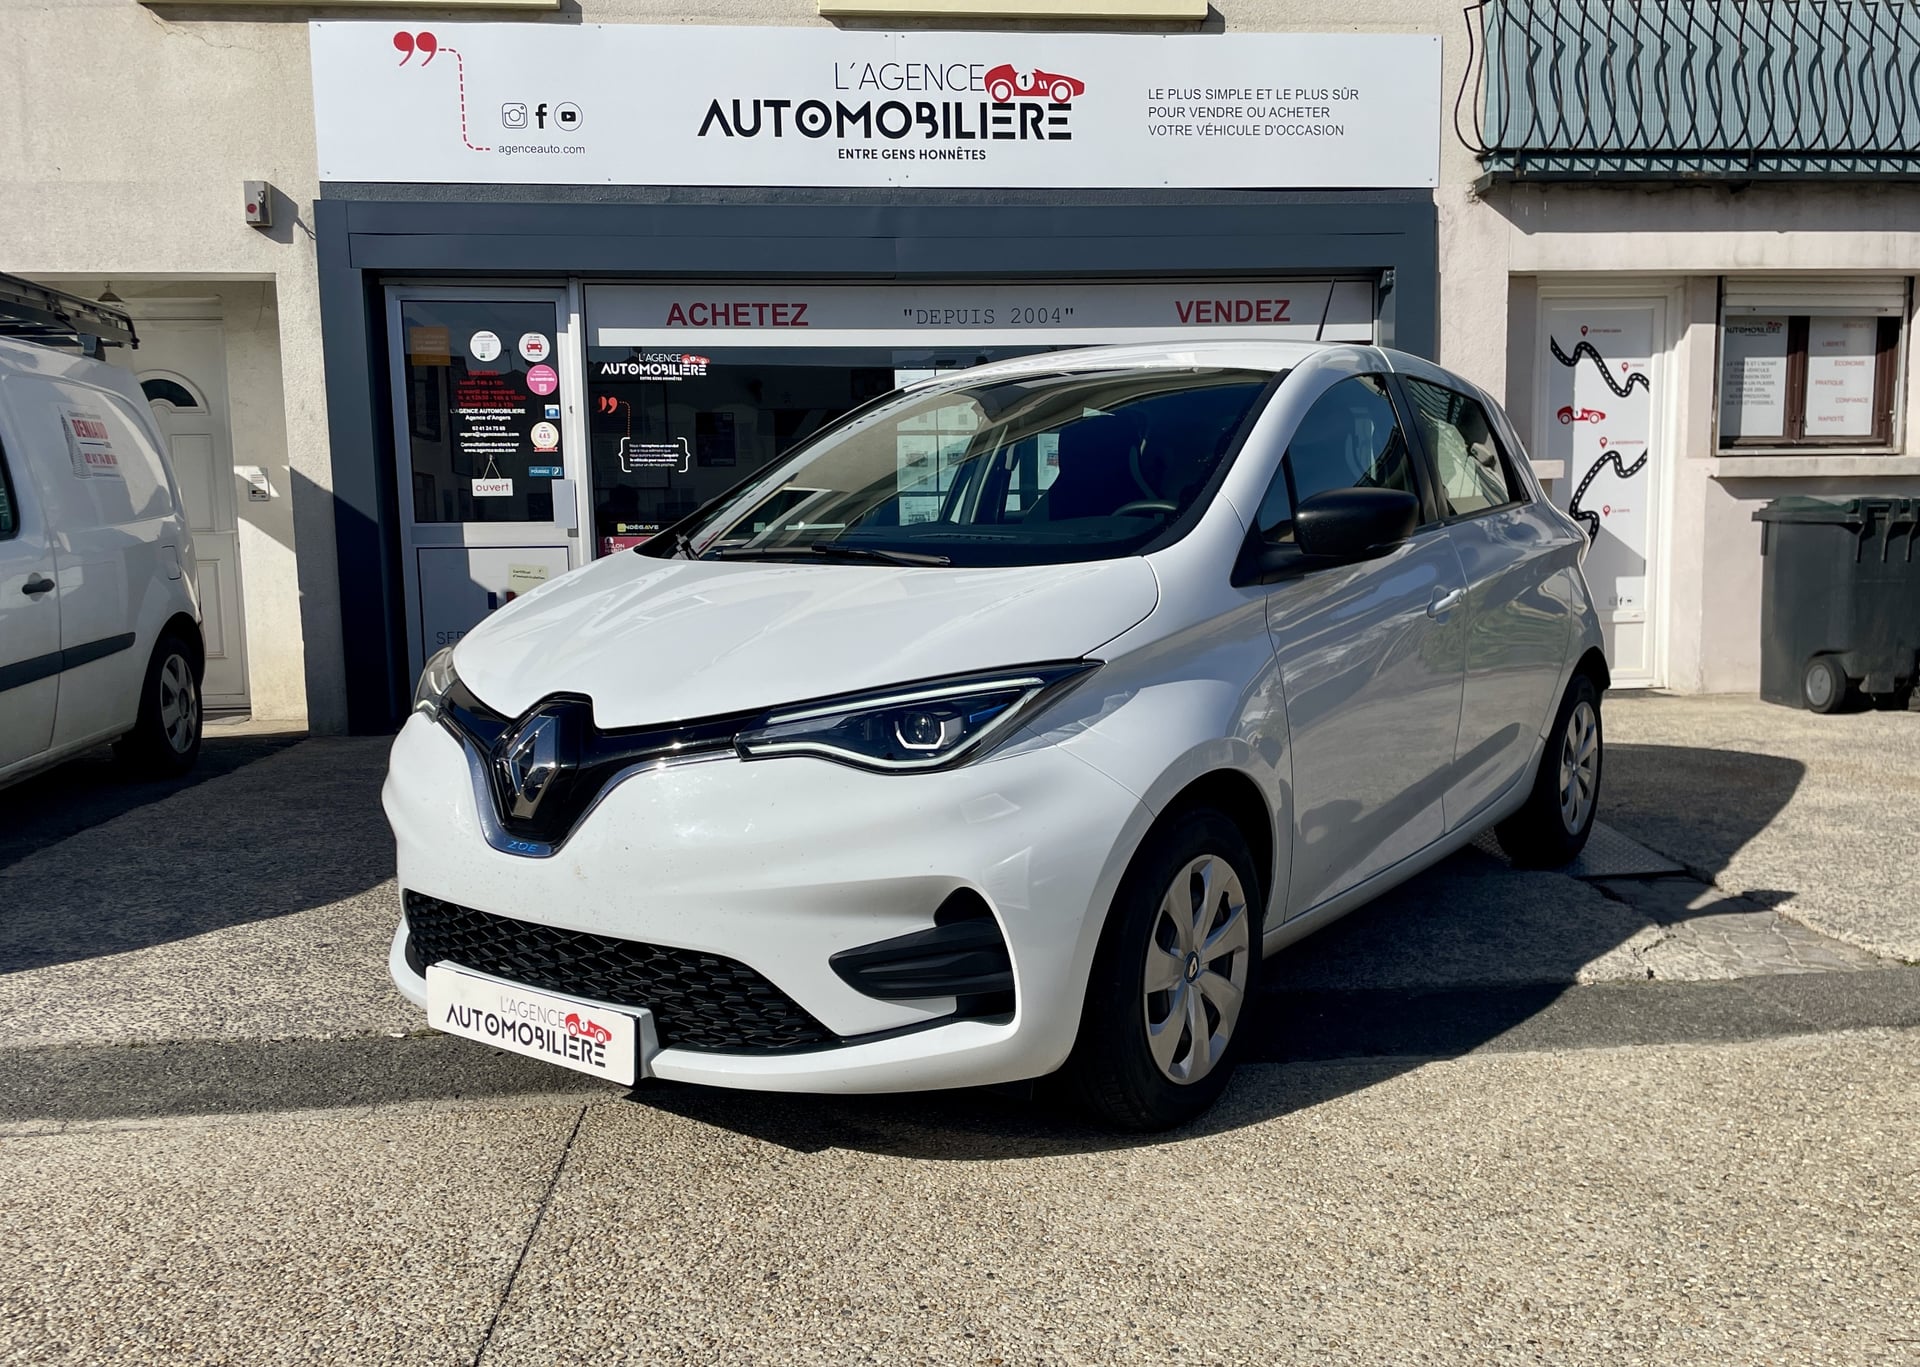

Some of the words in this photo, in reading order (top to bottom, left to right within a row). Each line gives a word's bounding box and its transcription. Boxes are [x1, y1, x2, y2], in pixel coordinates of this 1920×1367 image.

[834, 62, 985, 92] L'AGENCE
[1148, 88, 1164, 100] LE
[1167, 88, 1201, 100] PLUS
[1205, 88, 1253, 100] SIMPLE
[1256, 88, 1273, 100] ET
[1276, 88, 1292, 100] LE
[1295, 88, 1329, 101] PLUS
[1331, 86, 1359, 101] SÛR
[1148, 106, 1186, 118] POUR
[1188, 106, 1243, 118] VENDRE
[1246, 106, 1266, 118] OU
[1268, 106, 1330, 119] ACHETER
[1148, 124, 1193, 136] VOTRE
[1196, 122, 1261, 136] VÉHICULE
[1264, 124, 1344, 136] D'OCCASION
[498, 144, 586, 156] agenceauto.com
[838, 148, 879, 160] ENTRE
[881, 148, 916, 160] GENS
[919, 146, 987, 161] HONNÊTES
[665, 303, 809, 327] ACHETEZ
[1175, 300, 1291, 323] VENDEZ
[638, 353, 681, 363] L'AGENCE
[475, 483, 510, 493] ouvert
[500, 996, 566, 1030] L'AGENCE
